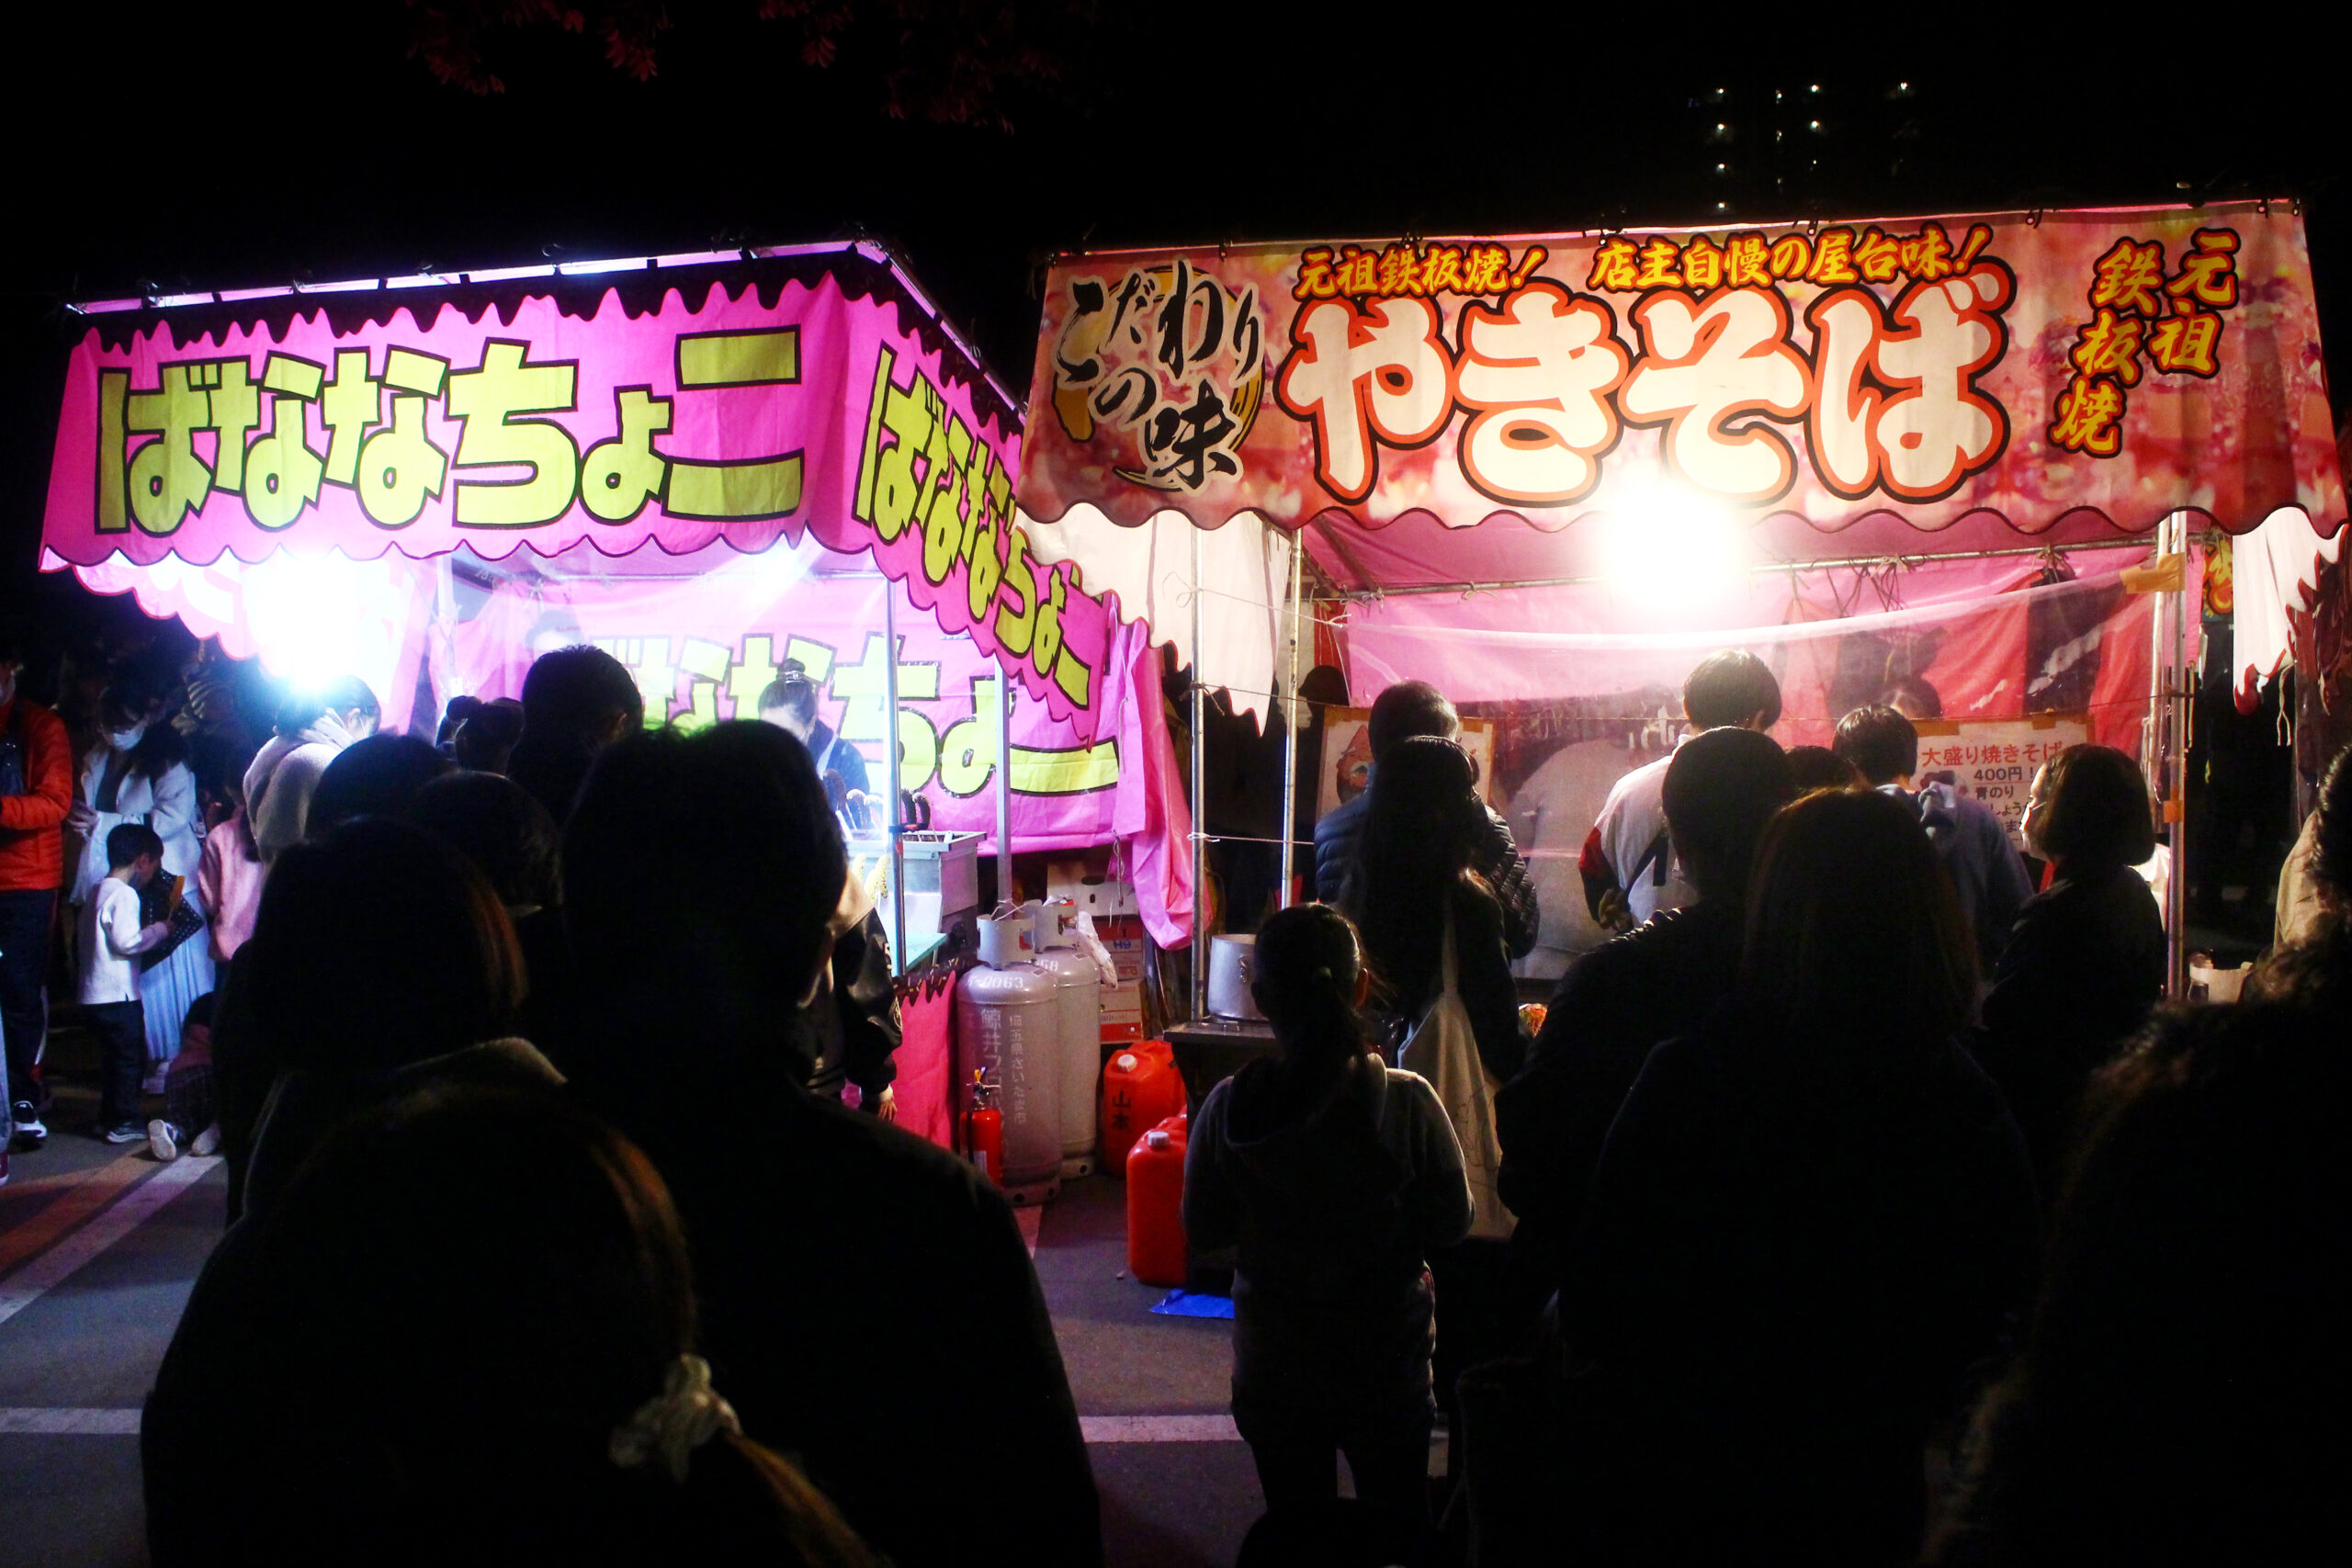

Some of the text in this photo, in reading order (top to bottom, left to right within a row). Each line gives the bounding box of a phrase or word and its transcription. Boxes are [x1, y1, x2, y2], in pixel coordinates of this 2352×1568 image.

[1295, 245, 1544, 296] 元祖鉄板焼！
[1591, 226, 1992, 288] 店主自慢の屋台味！
[2153, 230, 2238, 375] 元祖
[1275, 258, 2014, 507] やきそば
[2052, 238, 2165, 456] 鉄板焼
[95, 324, 804, 536] ばななちょこ
[1975, 785, 2015, 800] 青のり
[1112, 1090, 1131, 1130] 山本
